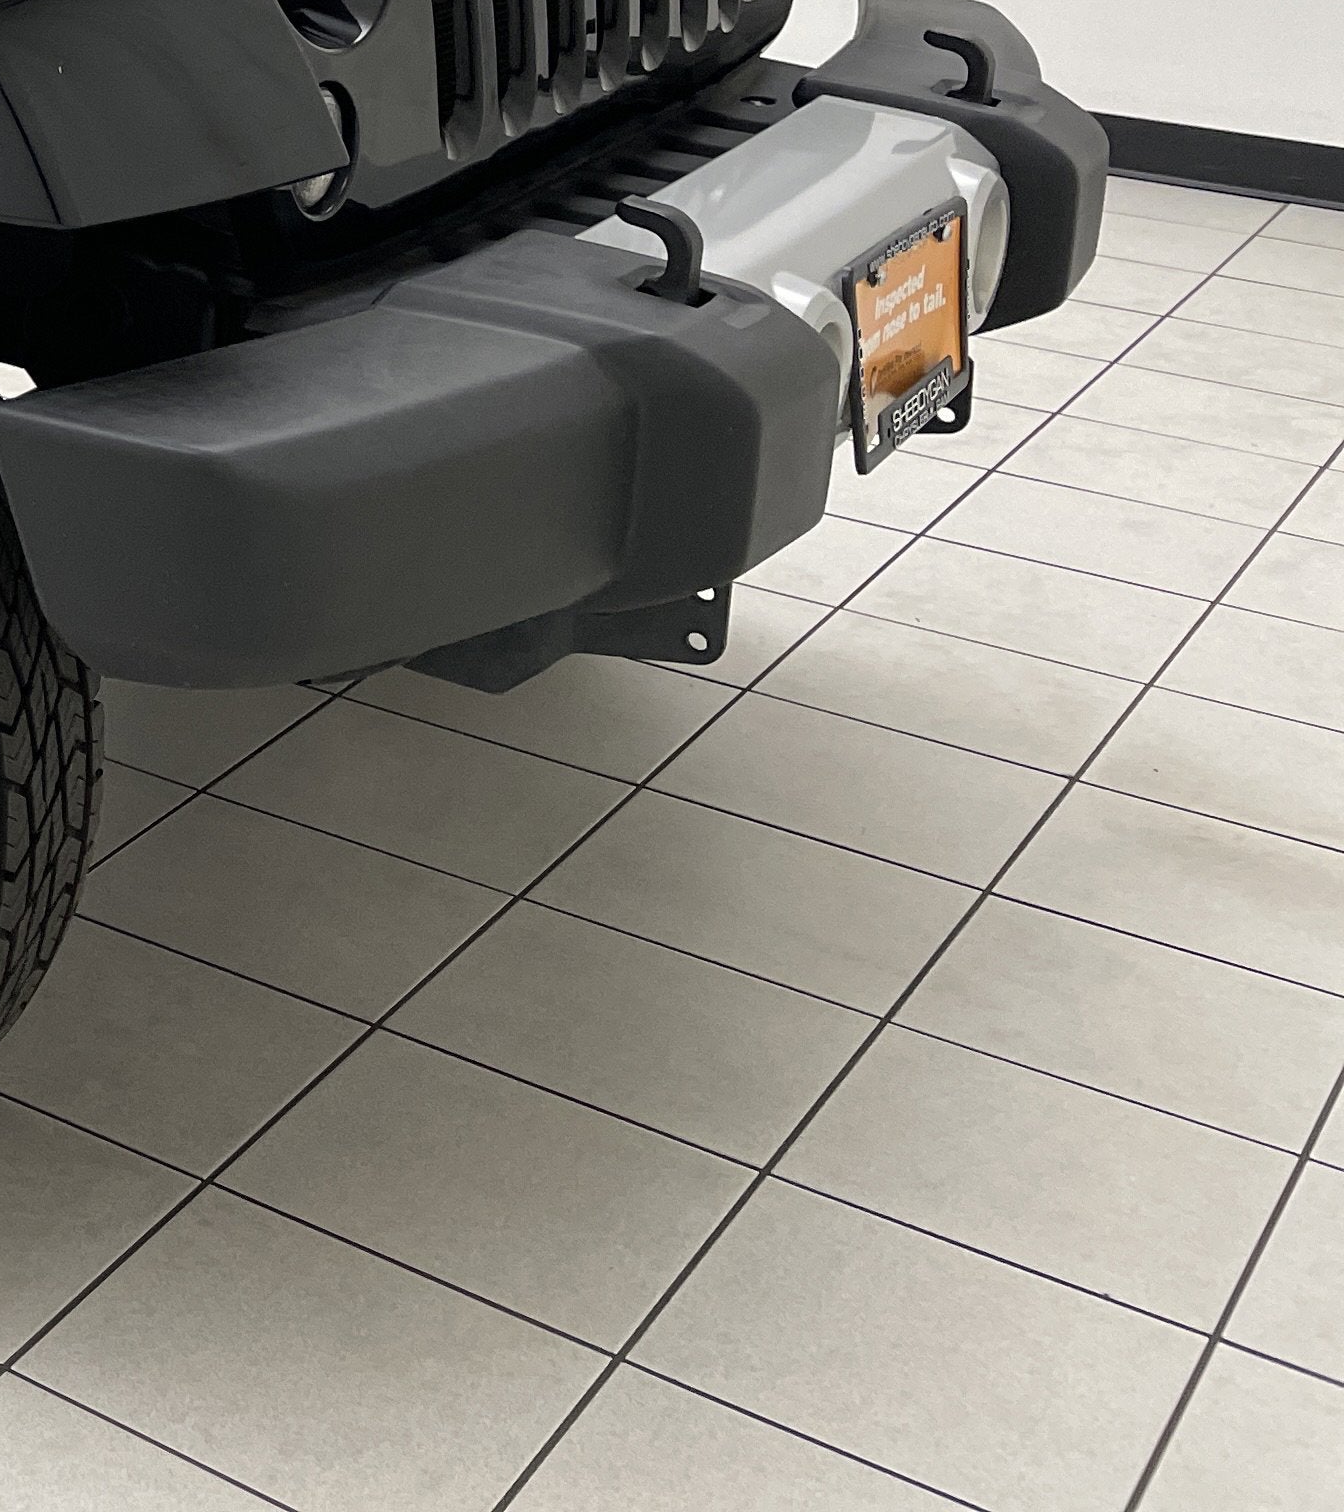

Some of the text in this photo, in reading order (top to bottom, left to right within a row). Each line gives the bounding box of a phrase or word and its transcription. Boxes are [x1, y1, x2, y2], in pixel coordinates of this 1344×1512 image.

[875, 264, 925, 321] Inspected
[909, 301, 920, 324] to
[892, 367, 950, 432] SHEBOYGAN
